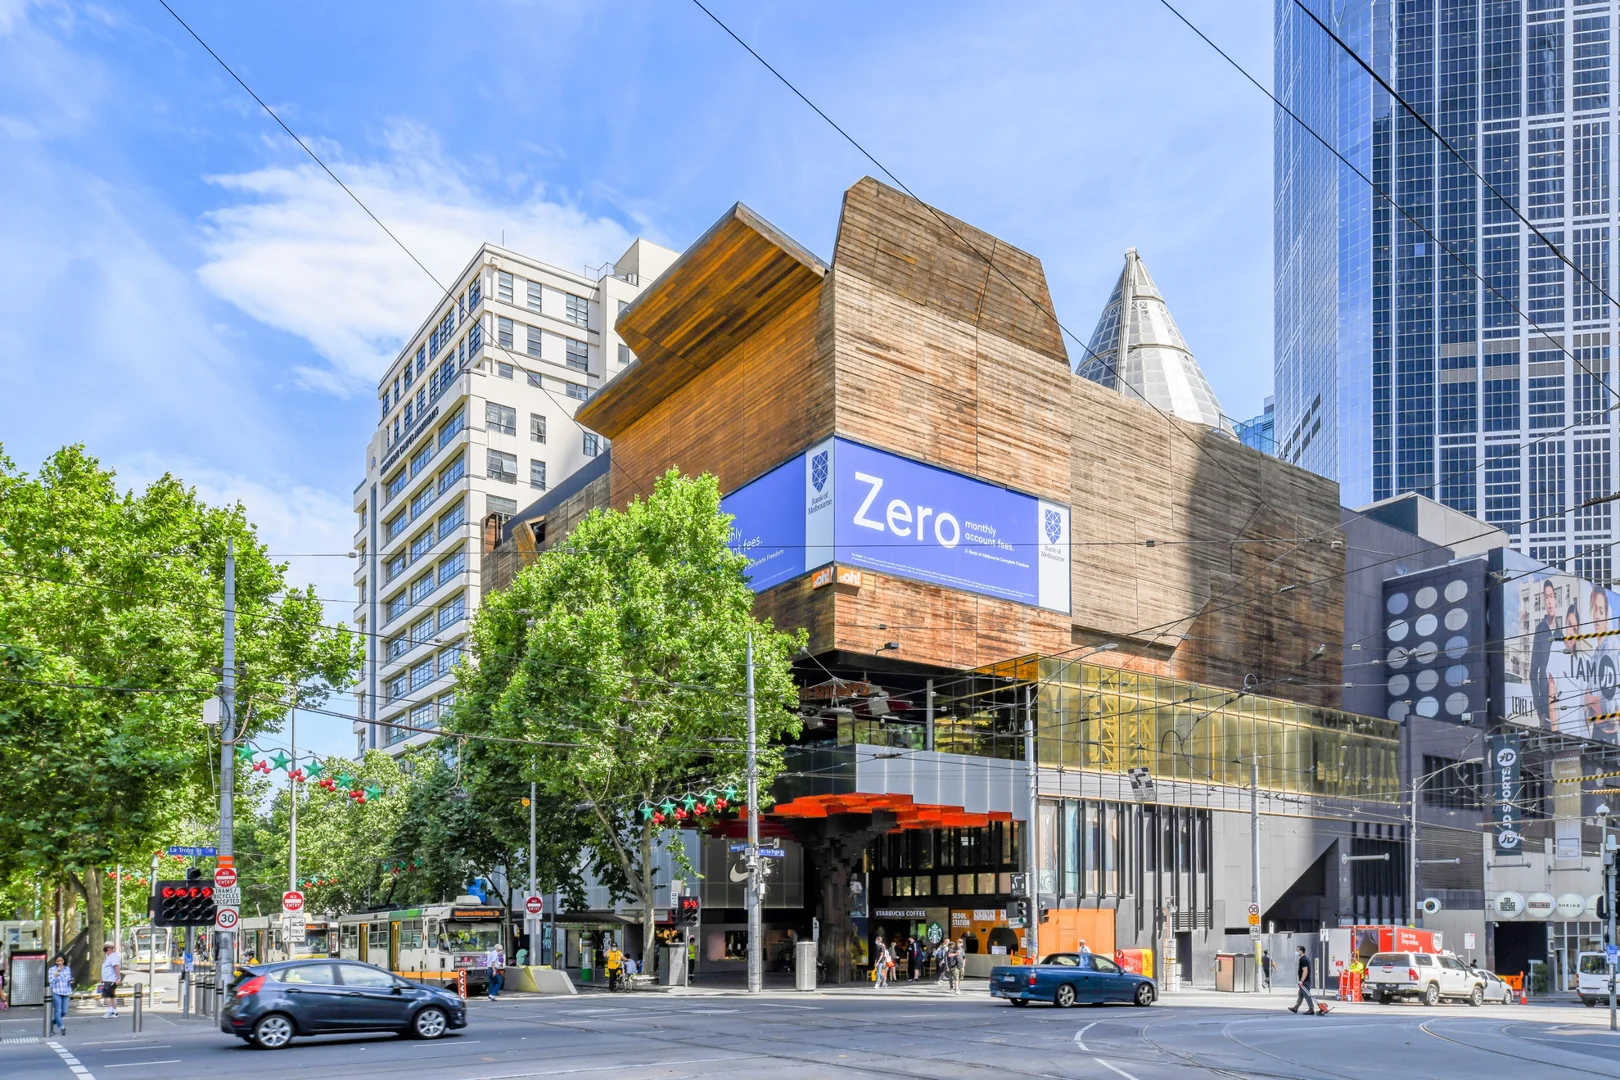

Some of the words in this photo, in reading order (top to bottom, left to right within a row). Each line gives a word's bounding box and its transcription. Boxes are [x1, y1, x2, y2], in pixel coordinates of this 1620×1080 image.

[807, 498, 832, 515] Melbourne
[811, 495, 821, 506] Bank
[821, 491, 828, 500] of
[853, 471, 960, 548] Zero
[965, 520, 997, 537] monthly
[743, 536, 763, 552] fees.
[964, 532, 996, 547] account
[997, 538, 1015, 552] fees.
[1044, 545, 1056, 553] Bank
[1040, 551, 1065, 562] Melbourne
[1576, 658, 1597, 685] AM
[1511, 696, 1528, 717] LEVEL
[1501, 766, 1512, 813] SPORTS
[1502, 815, 1512, 829] JD
[220, 914, 235, 923] 30
